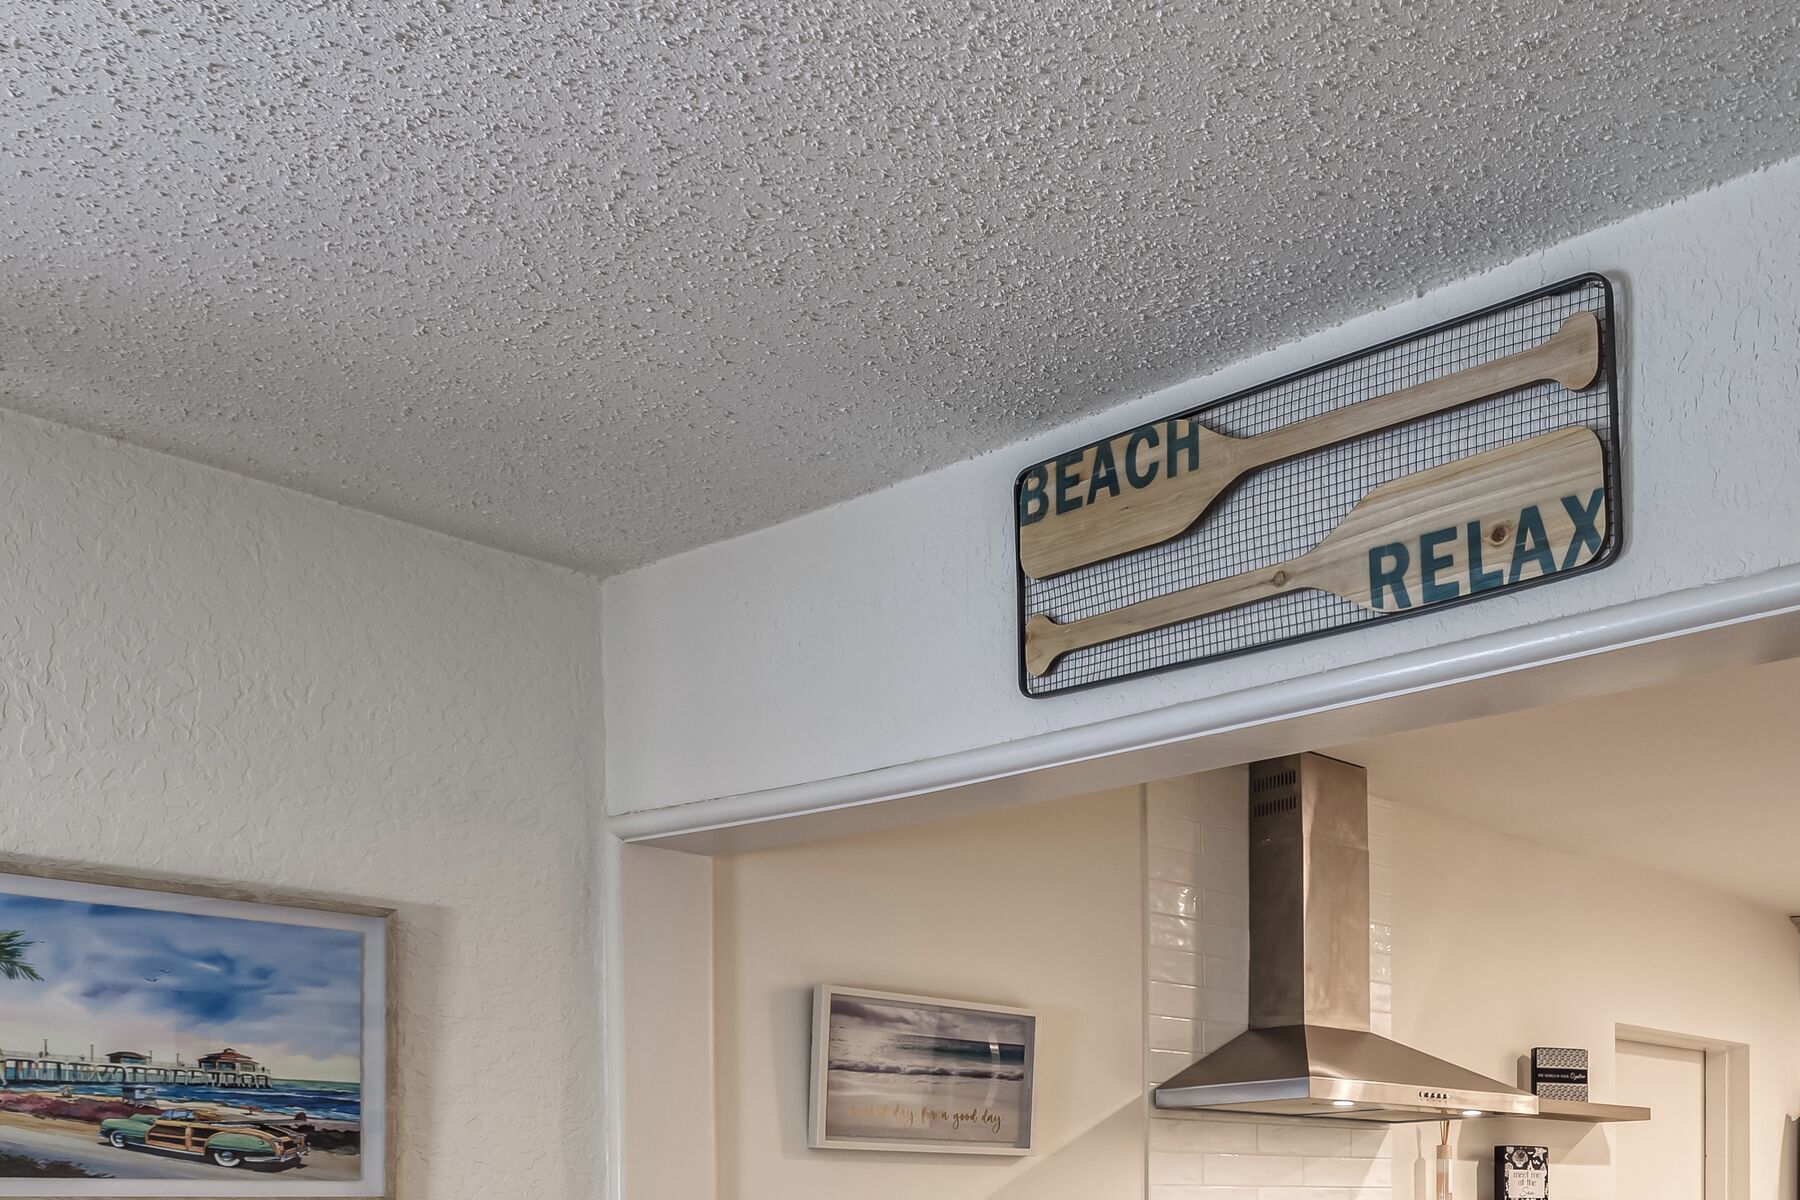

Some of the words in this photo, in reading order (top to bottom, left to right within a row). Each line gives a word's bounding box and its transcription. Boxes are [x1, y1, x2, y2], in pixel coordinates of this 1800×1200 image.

[1021, 419, 1200, 526] BEACH
[1368, 487, 1605, 609] RELAX
[952, 1108, 978, 1129] good
[981, 1108, 1002, 1134] day
